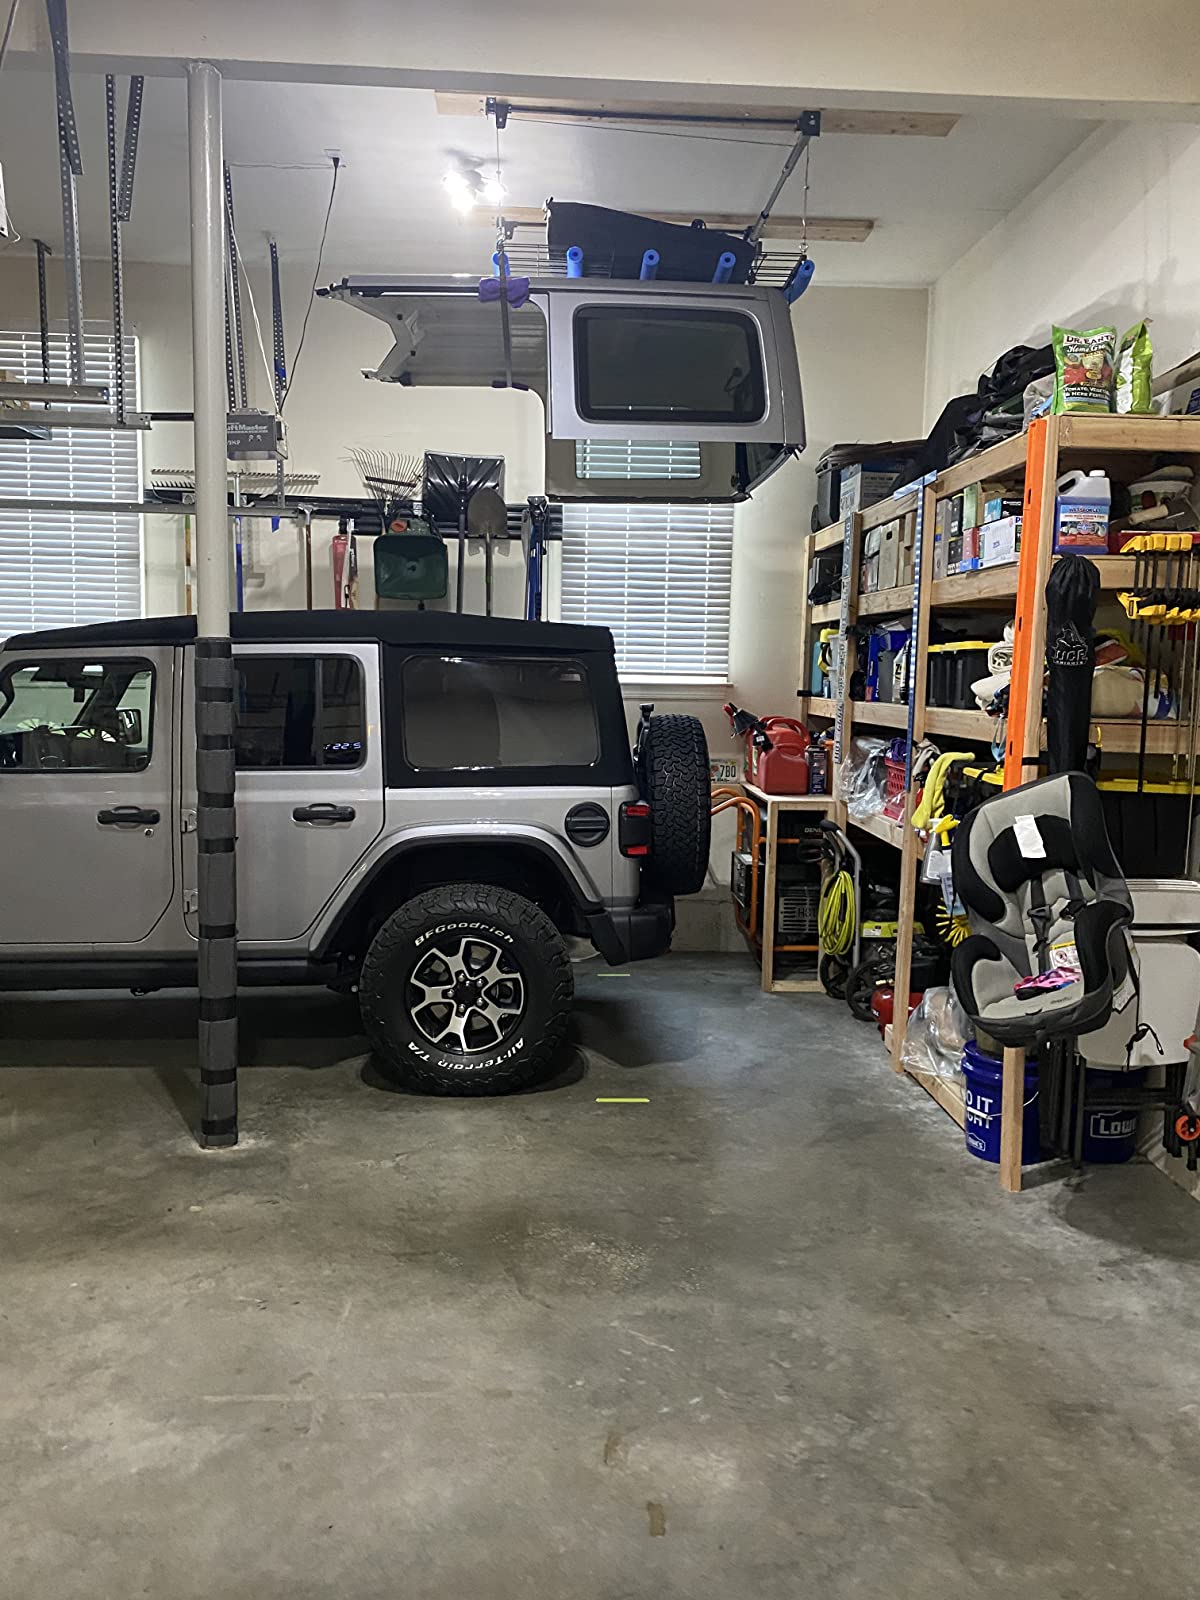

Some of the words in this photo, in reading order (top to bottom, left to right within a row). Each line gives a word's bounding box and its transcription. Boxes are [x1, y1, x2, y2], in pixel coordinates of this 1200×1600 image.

[414, 921, 514, 947] BFGoodrich
[407, 1041, 431, 1062] T/A
[437, 1036, 525, 1071] All-Terrain
[976, 1095, 994, 1113] IT
